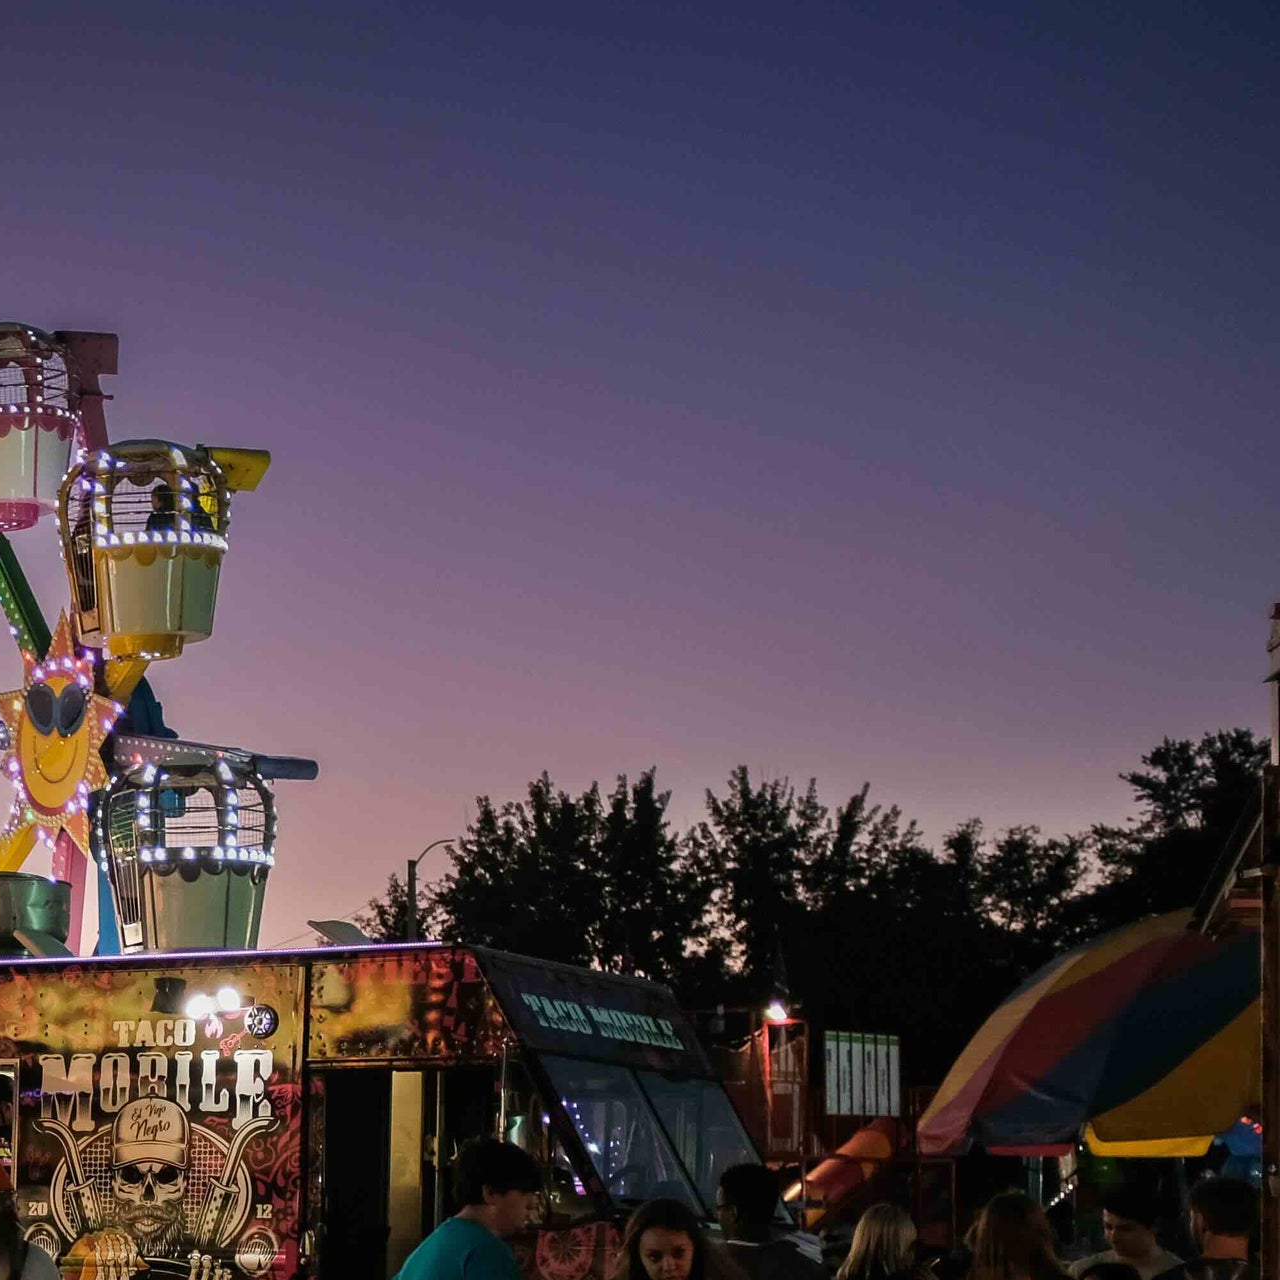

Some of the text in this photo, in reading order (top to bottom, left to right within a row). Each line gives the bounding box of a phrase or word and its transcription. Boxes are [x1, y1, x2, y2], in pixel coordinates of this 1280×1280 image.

[521, 993, 593, 1034] TACO
[112, 1019, 196, 1047] TACO
[39, 1049, 273, 1131] MOBILE
[130, 1119, 170, 1141] Negro
[28, 1202, 48, 1217] 20
[256, 1203, 273, 1218] 12
